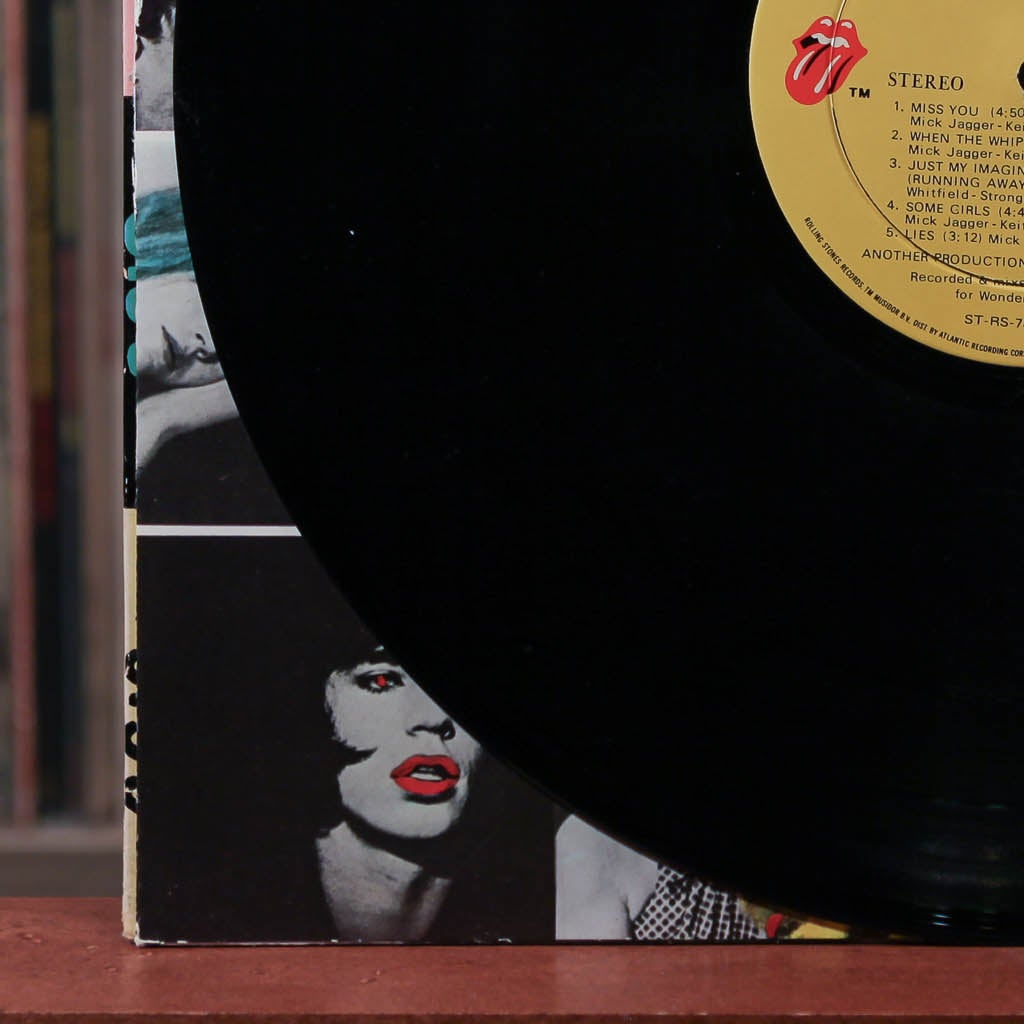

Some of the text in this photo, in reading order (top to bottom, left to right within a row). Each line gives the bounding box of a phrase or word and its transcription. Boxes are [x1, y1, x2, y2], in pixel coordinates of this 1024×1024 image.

[888, 72, 964, 91] STEREO
[849, 87, 871, 98] TM
[894, 101, 904, 112] 1.
[911, 103, 944, 115] MISS
[949, 105, 979, 117] YOU
[910, 116, 942, 127] Mick
[891, 130, 902, 141] 2.
[910, 131, 949, 143] WHEN
[956, 134, 982, 146] THE
[989, 136, 1023, 147] WHIP
[908, 145, 940, 156] Mick
[889, 158, 901, 169] 3.
[908, 160, 944, 171] JUST
[949, 162, 967, 173] MY
[908, 174, 980, 188] (RUNNING
[887, 200, 899, 211] 4.
[906, 202, 944, 214] SOME
[950, 204, 990, 217] GIRLS
[905, 214, 937, 226] Mick
[886, 227, 898, 238] 5.
[905, 229, 935, 241] LIES
[943, 232, 982, 244] (3:12)
[988, 234, 1020, 245] Mick
[861, 249, 928, 262] ANOTHER
[910, 271, 973, 285] Recorded
[978, 275, 988, 285] &
[804, 217, 824, 243] ROLLING
[821, 242, 842, 264] STONES
[873, 294, 900, 316] MUSIDOR
[929, 327, 938, 336] BY
[939, 331, 969, 348] ATLANTIC
[971, 342, 1008, 356] RECORDING
[955, 289, 973, 300] for
